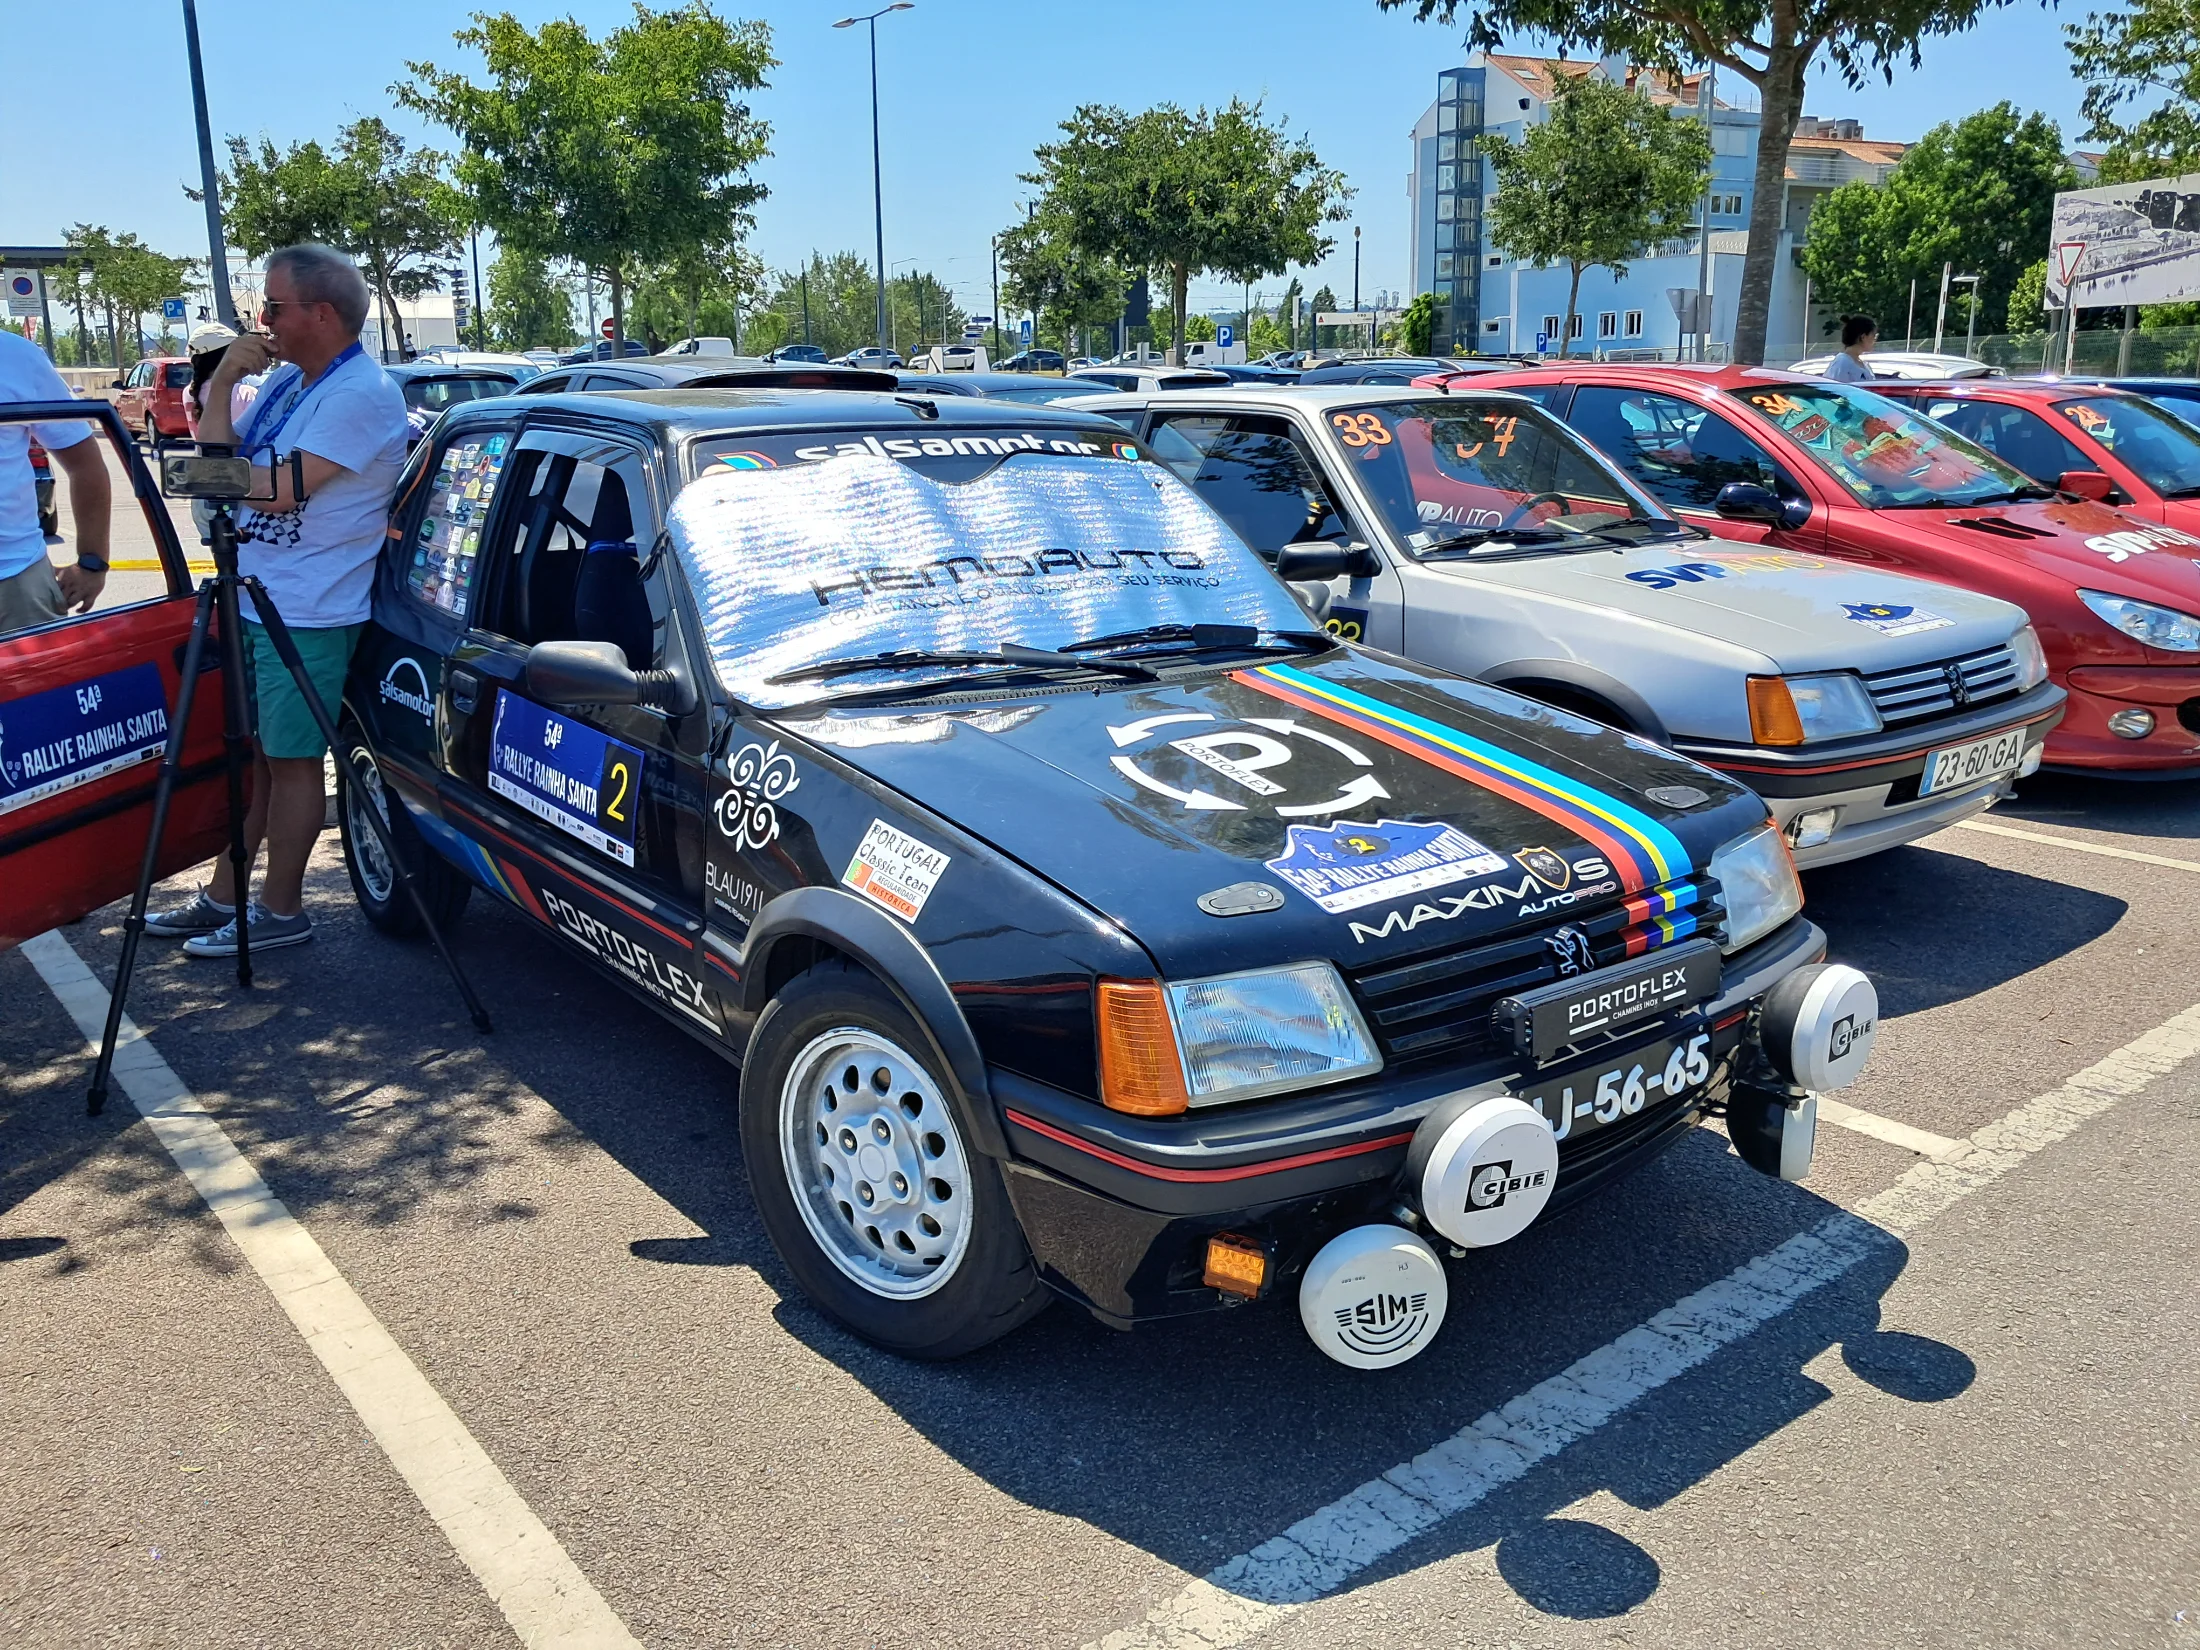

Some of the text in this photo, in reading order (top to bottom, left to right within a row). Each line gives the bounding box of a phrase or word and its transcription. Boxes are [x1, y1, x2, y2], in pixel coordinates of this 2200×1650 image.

[166, 302, 175, 316] P
[1219, 327, 1230, 345] P
[1538, 334, 1546, 350] P
[1751, 393, 1802, 415] 34
[1333, 413, 1392, 446] 33
[1117, 575, 1149, 587] SEU
[1153, 575, 1220, 590] SERVIÇO
[76, 684, 102, 715] 54ª
[379, 680, 435, 717] salsamotor
[22, 708, 167, 779] RALLYE RAINHA SANTA
[544, 719, 563, 749] 54ª
[503, 744, 598, 818] RALLYE RAINHA SANTA
[1180, 742, 1276, 792] PORTOFLEX
[606, 762, 628, 822] 2
[868, 824, 942, 875] PORTUGAL
[1318, 863, 1391, 888] RALLYE
[1380, 848, 1438, 875] RAINHA
[1425, 828, 1491, 863] SANTA
[1349, 838, 1376, 852] 2
[859, 843, 929, 895] Classic Team
[871, 885, 910, 913] HISTÓRICA
[877, 875, 917, 903] REGULARIDADE
[541, 888, 715, 1017] PORTOFLEX
[643, 978, 668, 1002] INOX
[1568, 966, 1687, 1024] PORTOFLEX
[1643, 998, 1659, 1010] INOX
[1839, 1020, 1871, 1046] CIBIE
[1533, 1033, 1710, 1141] J-56-65
[1483, 1173, 1545, 1195] CIBIE
[1356, 1293, 1408, 1326] SIM
